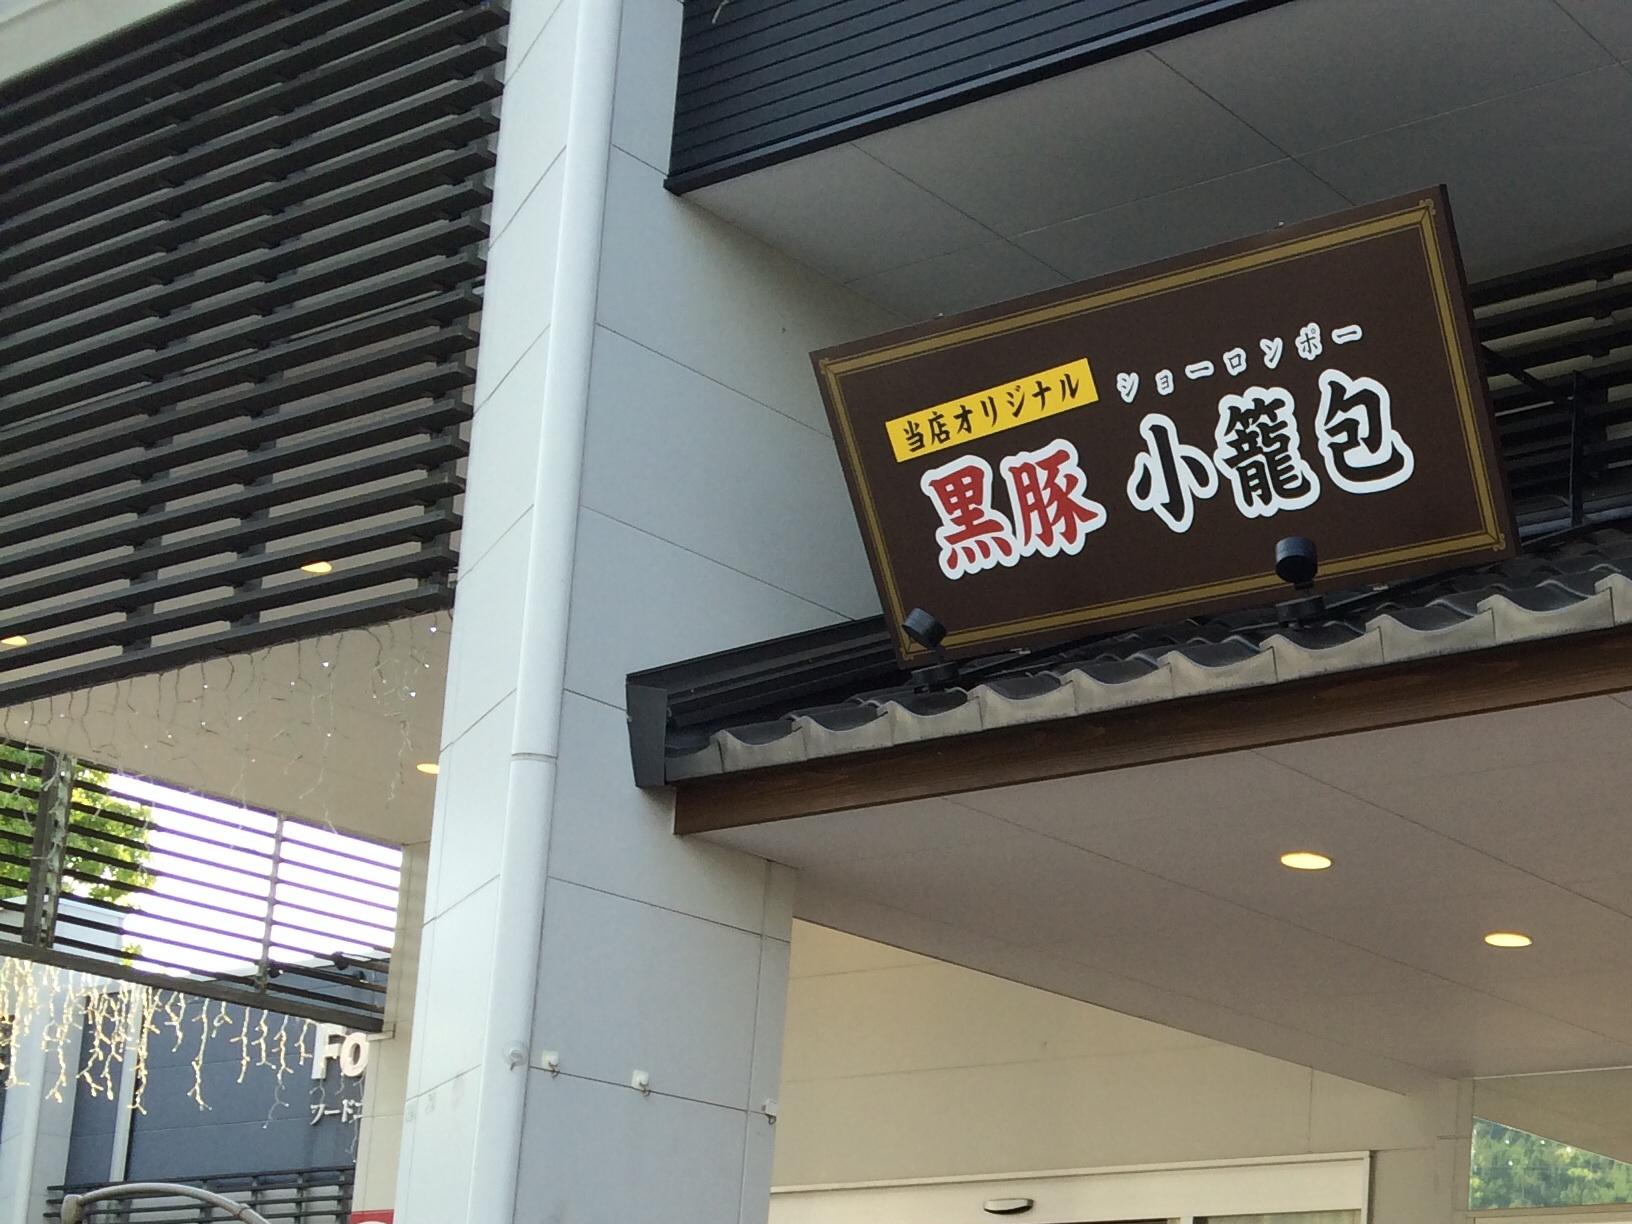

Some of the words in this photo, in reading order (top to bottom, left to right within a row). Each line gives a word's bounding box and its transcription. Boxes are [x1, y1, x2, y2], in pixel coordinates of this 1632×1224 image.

[1116, 322, 1363, 403] ショーロンポー
[902, 371, 1080, 454] 当店オリジナル
[921, 439, 1106, 580] 黒豚
[1126, 369, 1414, 533] 小籠包
